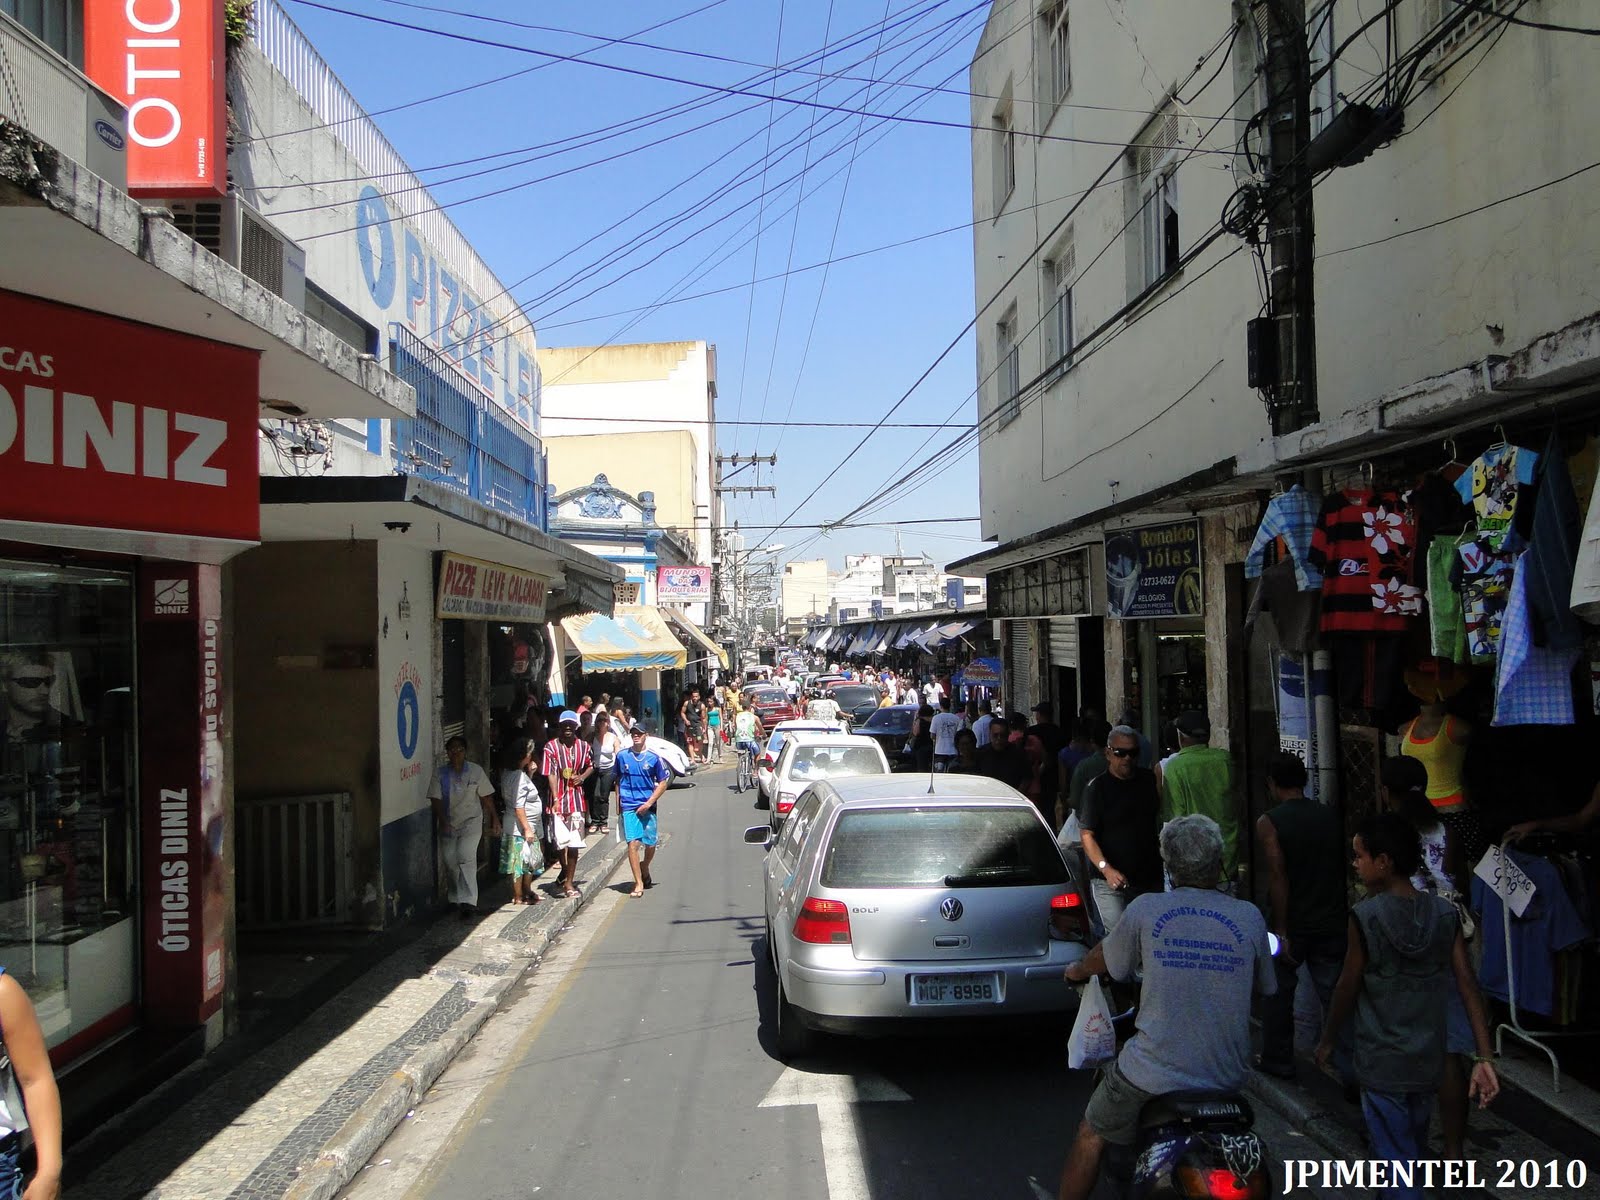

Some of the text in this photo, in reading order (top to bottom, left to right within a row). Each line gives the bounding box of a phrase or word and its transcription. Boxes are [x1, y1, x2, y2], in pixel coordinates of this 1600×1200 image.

[97, 123, 122, 147] Carrier
[1141, 526, 1195, 547] Ronaldo
[444, 559, 477, 599] PIZZE
[481, 569, 506, 600] LEVE
[154, 605, 189, 615] DINIZ
[948, 597, 957, 609] G
[158, 788, 190, 952] ÓTICAS DINIZ
[1152, 906, 1245, 945] ELETRICISTA COMERCIAL
[1164, 938, 1234, 953] E RESIDENCIAL
